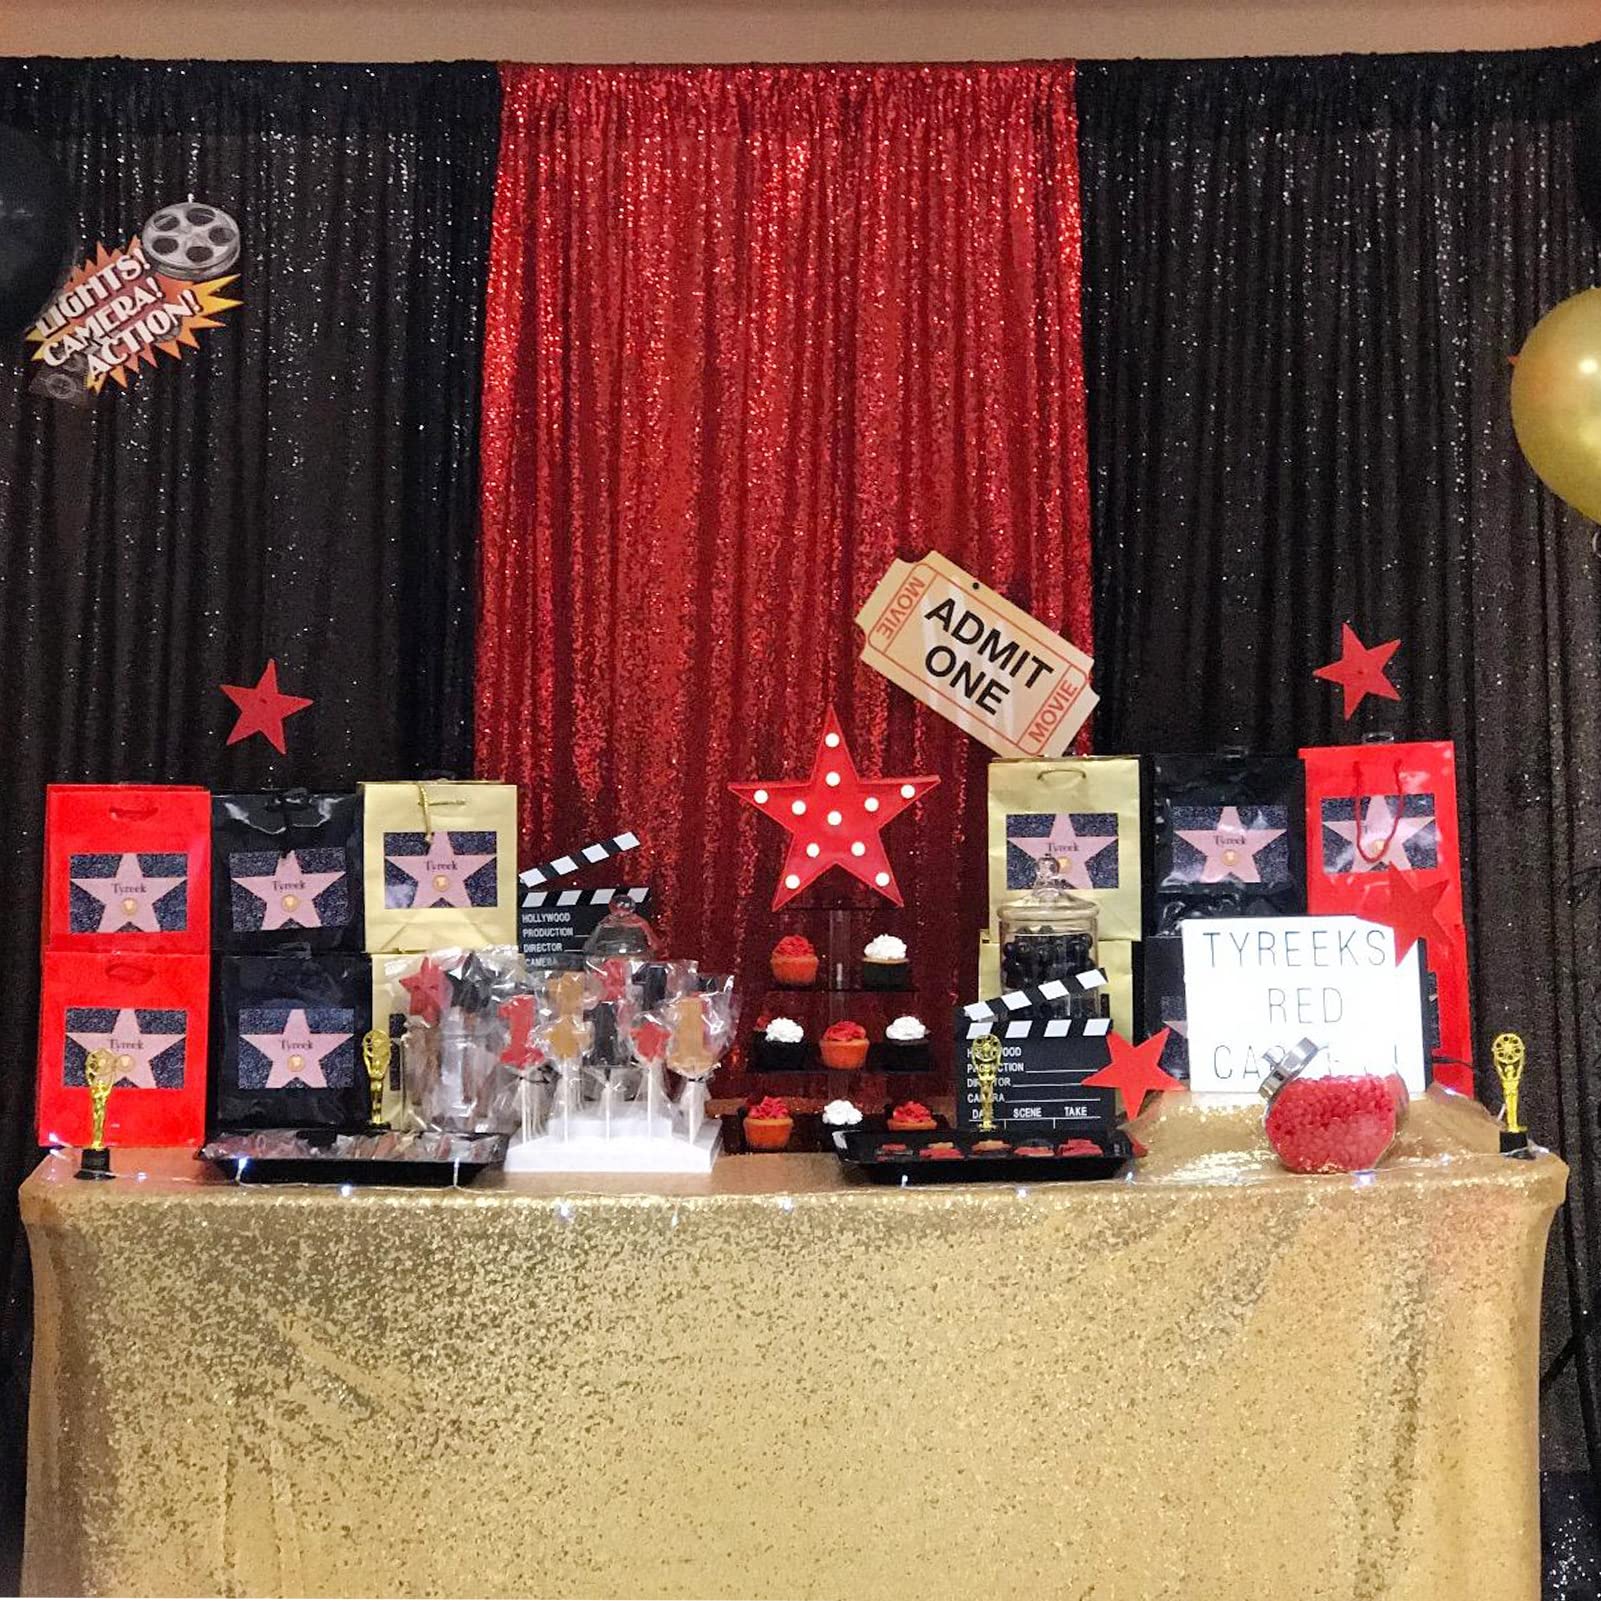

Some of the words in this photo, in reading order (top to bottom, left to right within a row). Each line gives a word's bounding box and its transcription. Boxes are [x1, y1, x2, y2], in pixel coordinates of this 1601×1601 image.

[35, 247, 151, 338] LIGHTS!
[43, 276, 164, 367] CAMERA!
[87, 289, 202, 381] ACTION!
[876, 576, 926, 640] MOVIE
[924, 597, 1055, 689] ADMIT
[925, 645, 1011, 716] ONE
[1027, 679, 1078, 744] MOVIE
[521, 912, 571, 924] HOLLYWOOD
[522, 927, 574, 938] PRODUCTION
[523, 942, 563, 953] DIRECTOR
[1202, 929, 1387, 968] TYREEKS
[1267, 987, 1343, 1024] RED
[1012, 1106, 1043, 1119] SCENE
[1063, 1106, 1088, 1117] TAKE
